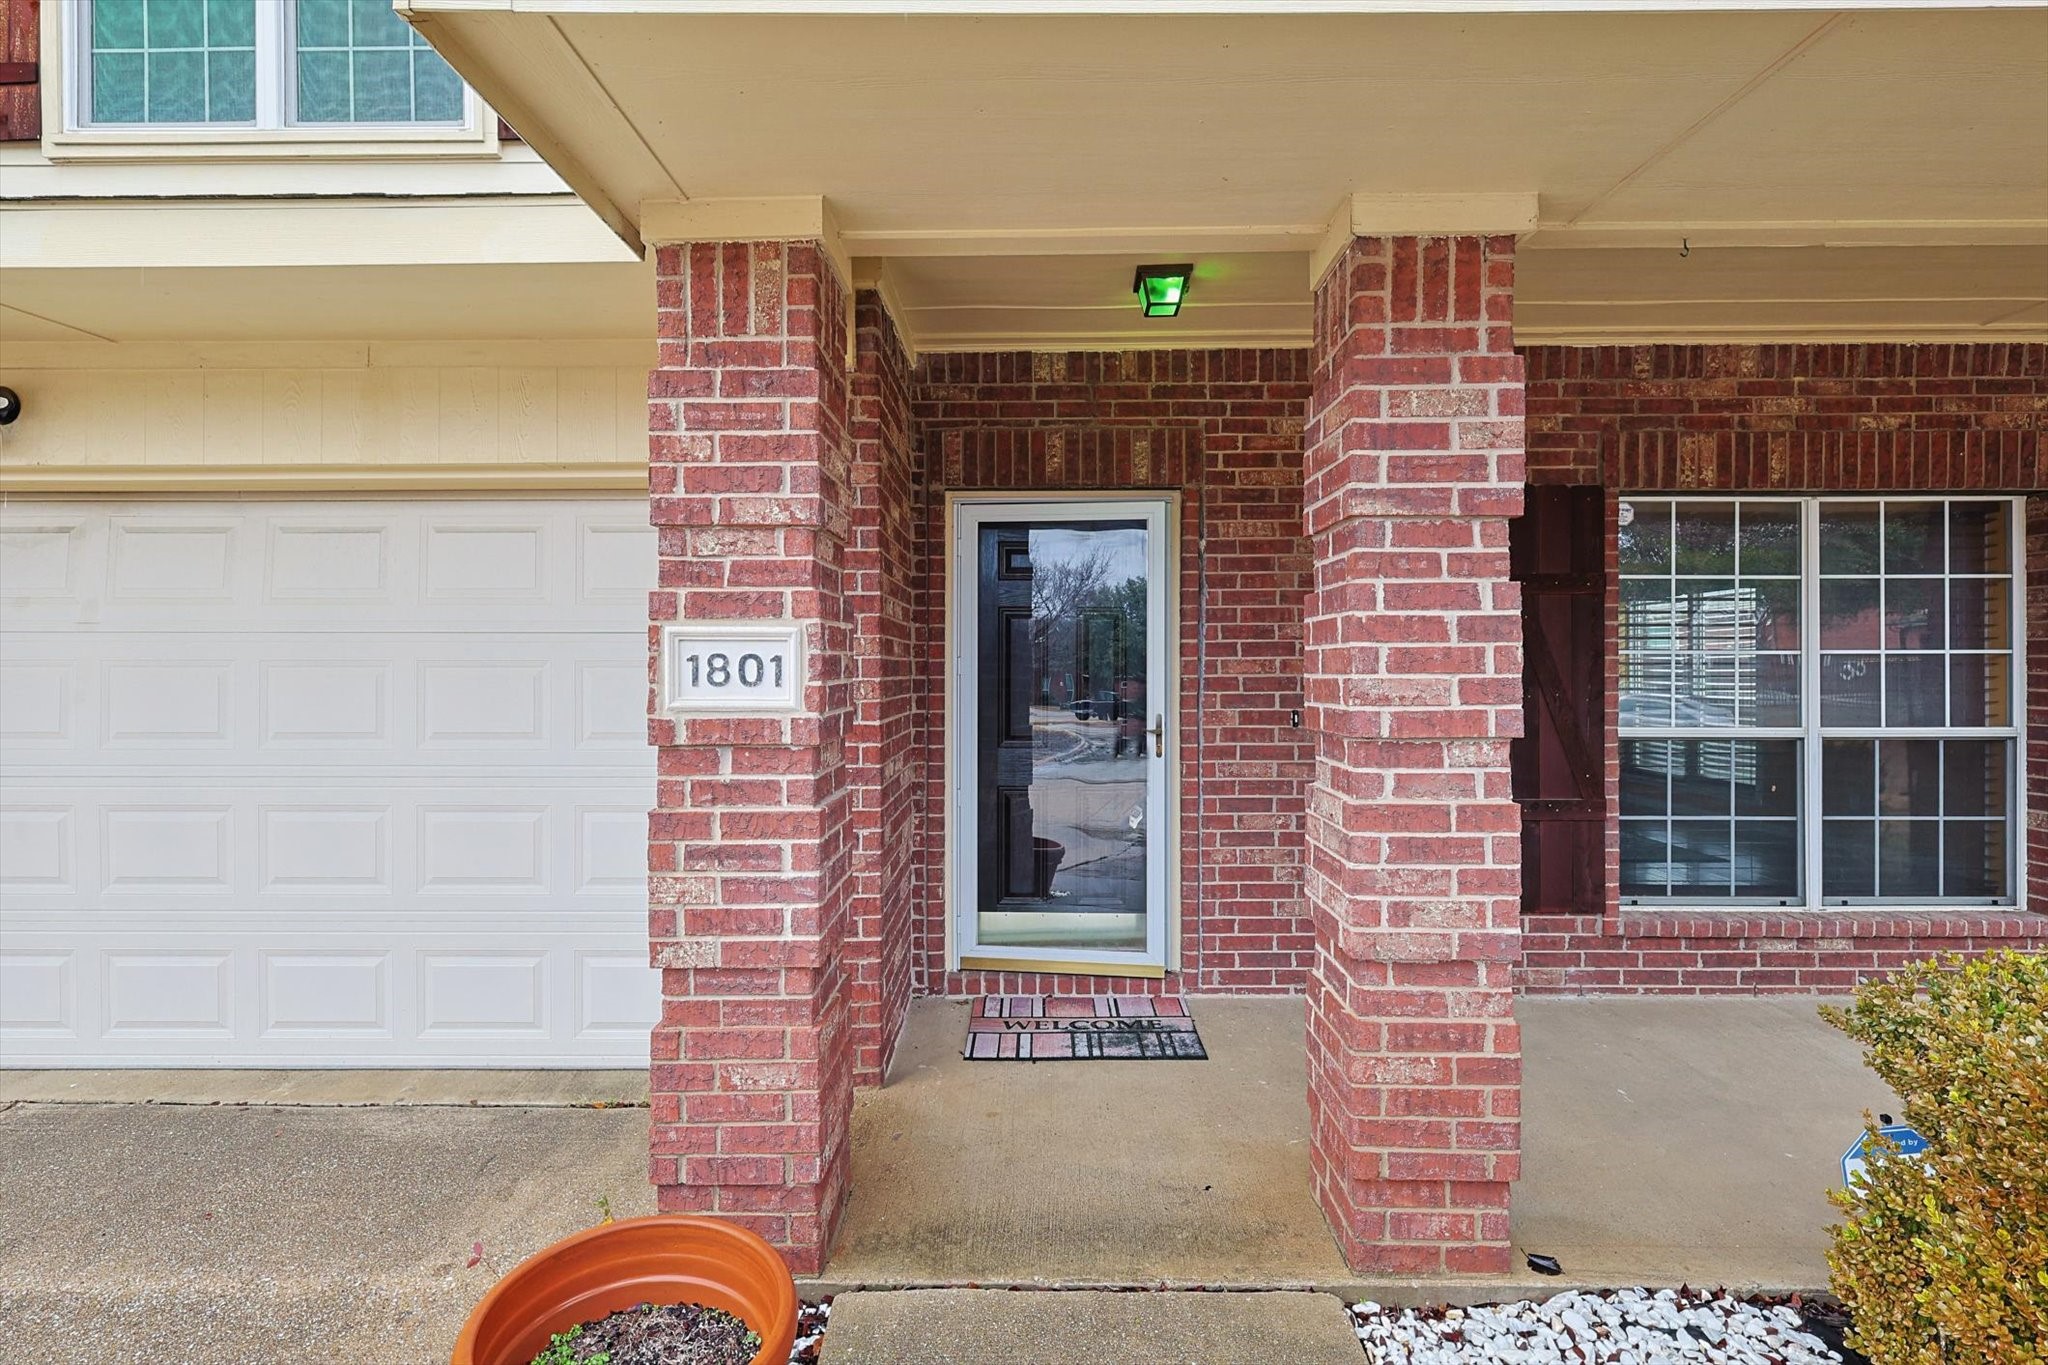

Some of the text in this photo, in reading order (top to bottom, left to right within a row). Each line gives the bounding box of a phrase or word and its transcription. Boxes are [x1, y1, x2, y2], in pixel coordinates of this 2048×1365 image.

[686, 653, 783, 688] 1801
[1002, 1019, 1164, 1031] WELCOME
[1907, 1138, 1918, 1147] by
